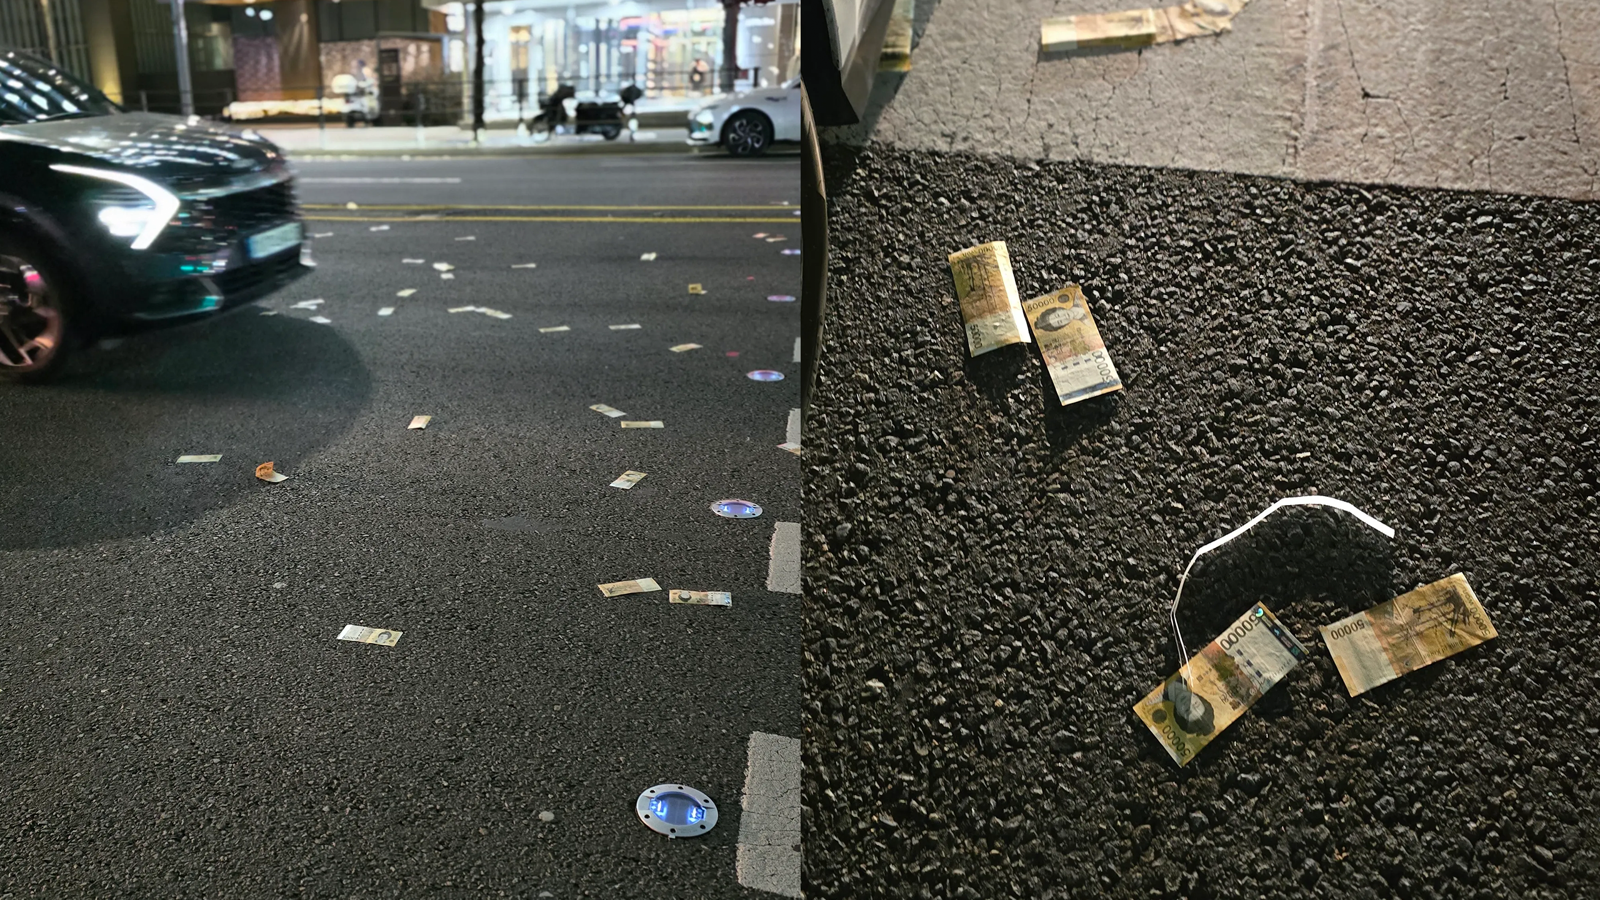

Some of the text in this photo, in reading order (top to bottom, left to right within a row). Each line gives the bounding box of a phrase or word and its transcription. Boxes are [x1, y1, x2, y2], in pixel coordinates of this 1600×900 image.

[1027, 297, 1055, 312] 50000
[1092, 350, 1114, 383] 50000
[1220, 612, 1261, 651] 50000
[1330, 618, 1366, 641] 50000
[1162, 725, 1192, 758] 50000
